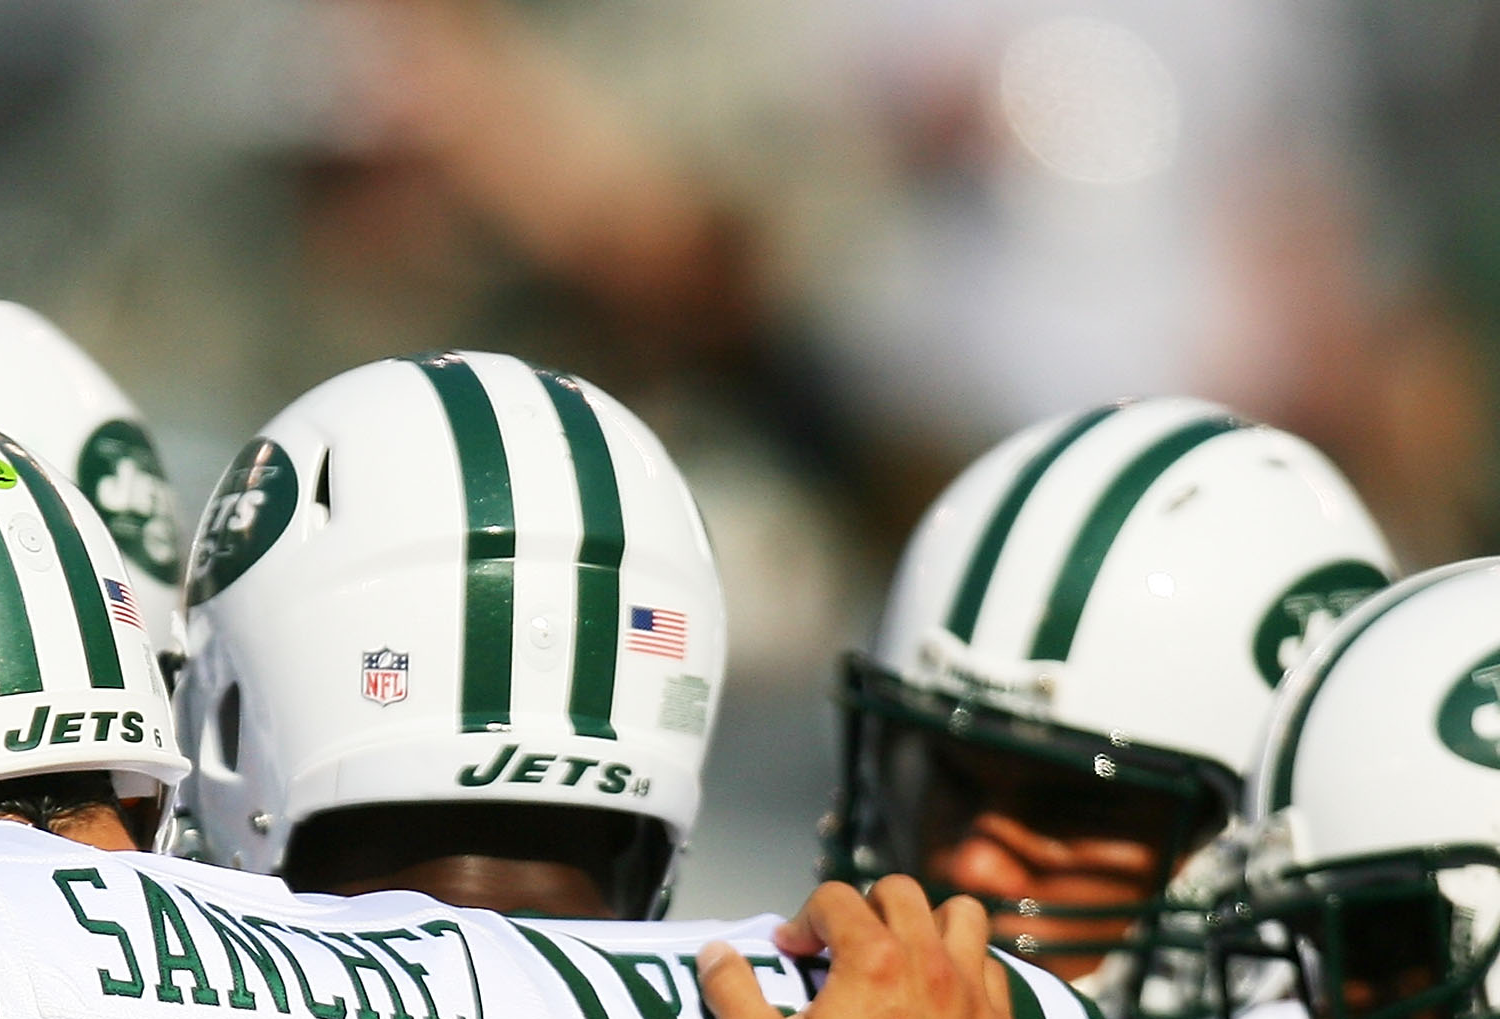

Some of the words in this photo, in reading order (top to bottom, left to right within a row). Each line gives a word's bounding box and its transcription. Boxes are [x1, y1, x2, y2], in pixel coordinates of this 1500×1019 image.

[365, 671, 404, 700] NFL
[4, 705, 145, 752] JETS
[153, 728, 162, 748] 6
[455, 743, 632, 793] JETS
